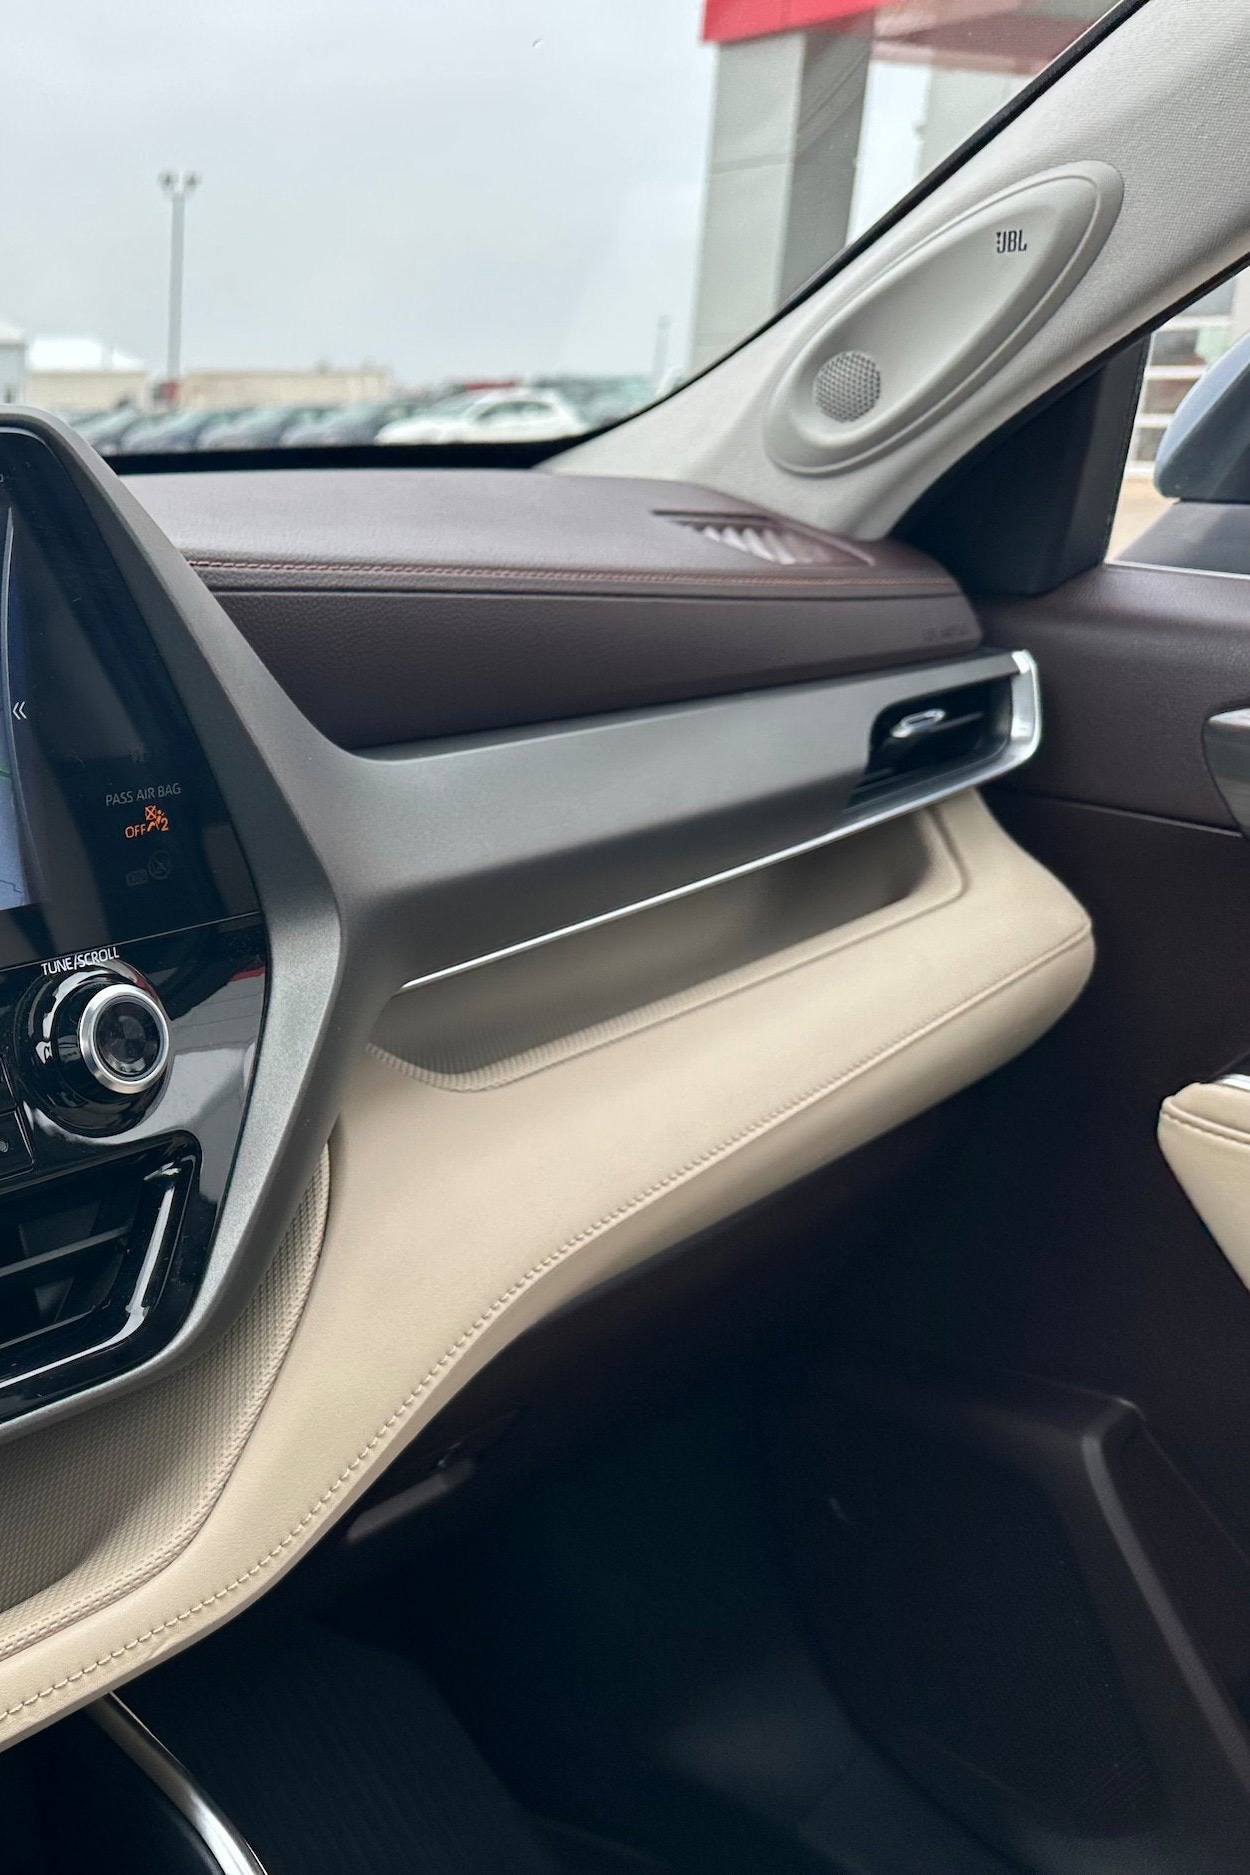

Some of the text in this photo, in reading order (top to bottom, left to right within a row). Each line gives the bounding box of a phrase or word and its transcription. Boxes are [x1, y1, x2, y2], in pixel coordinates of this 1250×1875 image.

[996, 229, 1027, 253] JBL
[105, 783, 181, 807] PASS AIR BAG
[125, 823, 146, 838] OFF
[41, 946, 120, 976] TUNE/SCROLL
